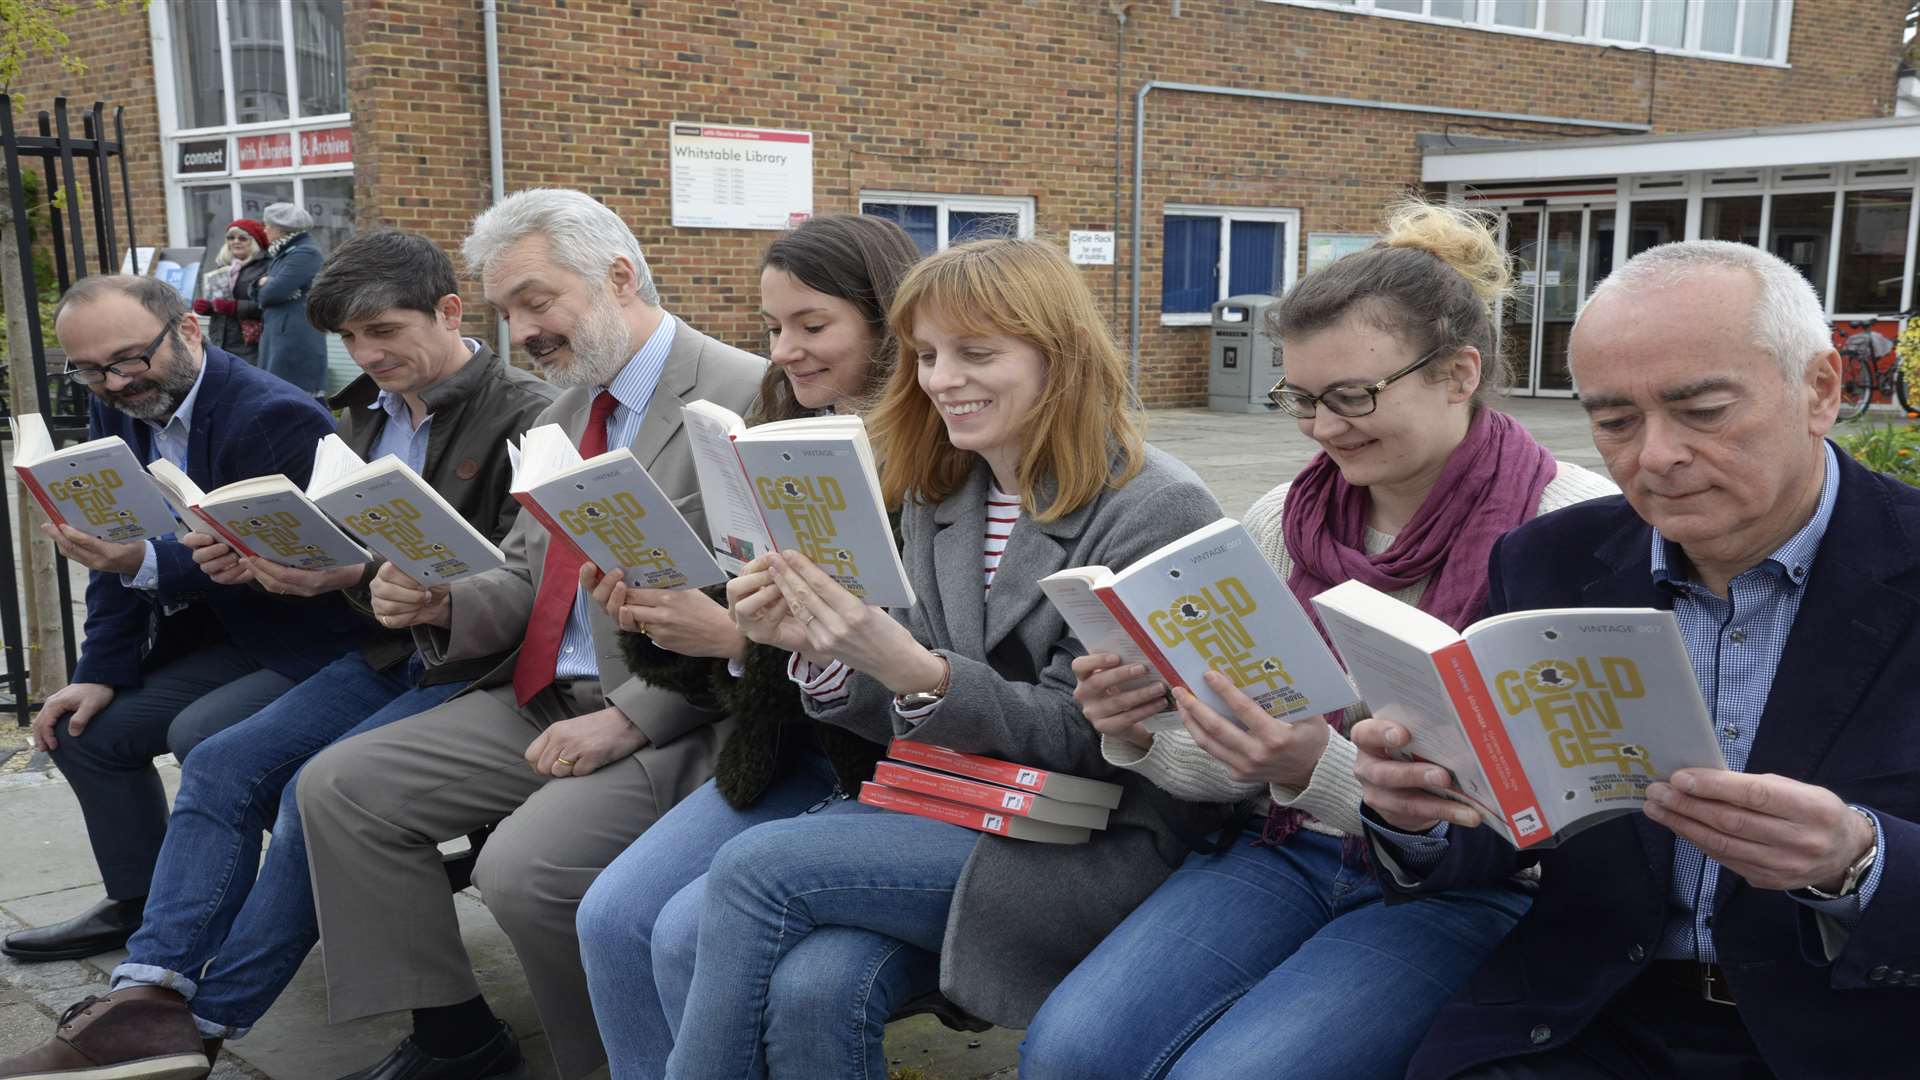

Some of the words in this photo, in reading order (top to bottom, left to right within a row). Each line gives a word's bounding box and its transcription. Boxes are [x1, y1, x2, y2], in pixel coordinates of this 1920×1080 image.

[184, 149, 223, 166] connect
[240, 145, 257, 161] with
[302, 140, 309, 154] &
[312, 137, 349, 156] Archives
[674, 145, 741, 161] Whitstable
[745, 150, 788, 166] Library
[1072, 233, 1092, 244] Cycle
[48, 468, 123, 500] GOLD
[755, 476, 848, 511] GOLD
[226, 511, 301, 536] GOLD
[344, 499, 422, 536] GOLD
[558, 491, 646, 536] GOLD
[1190, 543, 1225, 564] VINTAGE
[1148, 576, 1257, 648] GOLD
[1579, 623, 1633, 633] VINTAGE
[1495, 656, 1645, 716] GOLD
